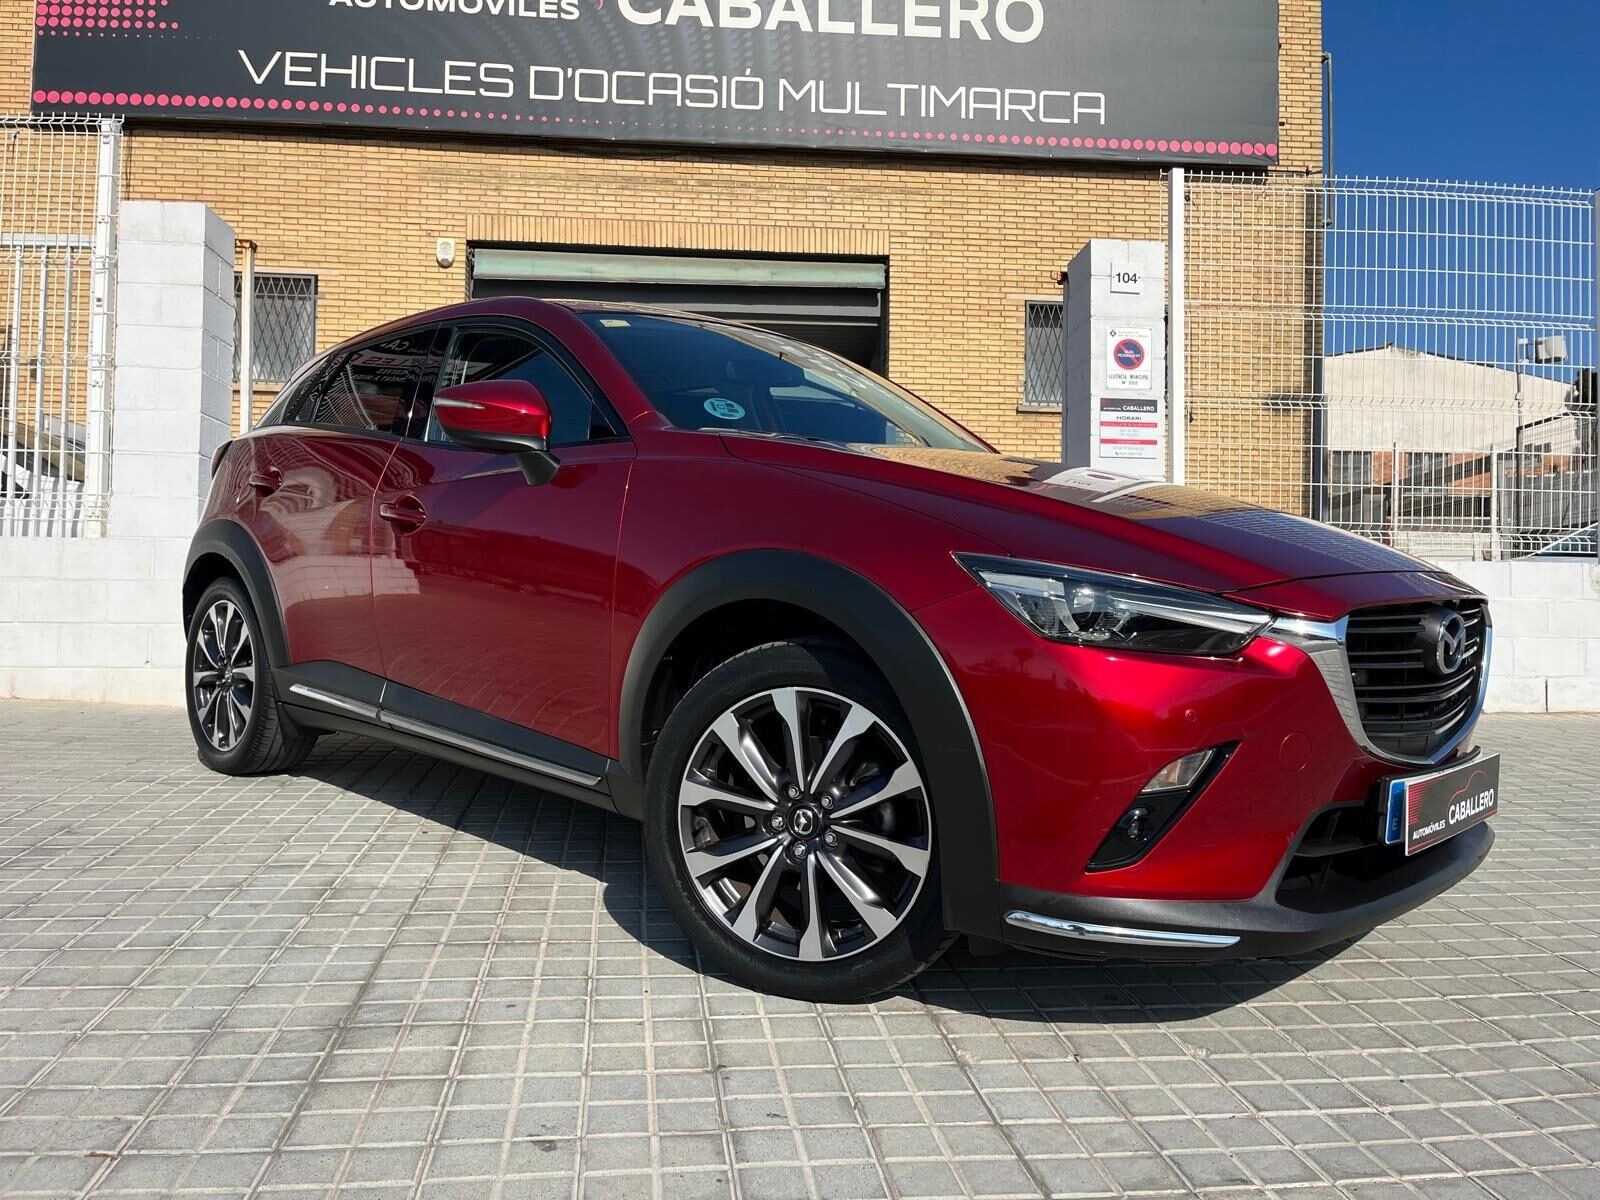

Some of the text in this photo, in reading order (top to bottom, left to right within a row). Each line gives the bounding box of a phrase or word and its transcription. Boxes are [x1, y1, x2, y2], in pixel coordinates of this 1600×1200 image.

[617, 0, 1045, 44] CABALLERO
[238, 49, 1105, 125] VEHICLES D'OCASIÓ MULTIMARCA
[1115, 272, 1138, 284] 104
[1448, 788, 1495, 825] CABALLERO
